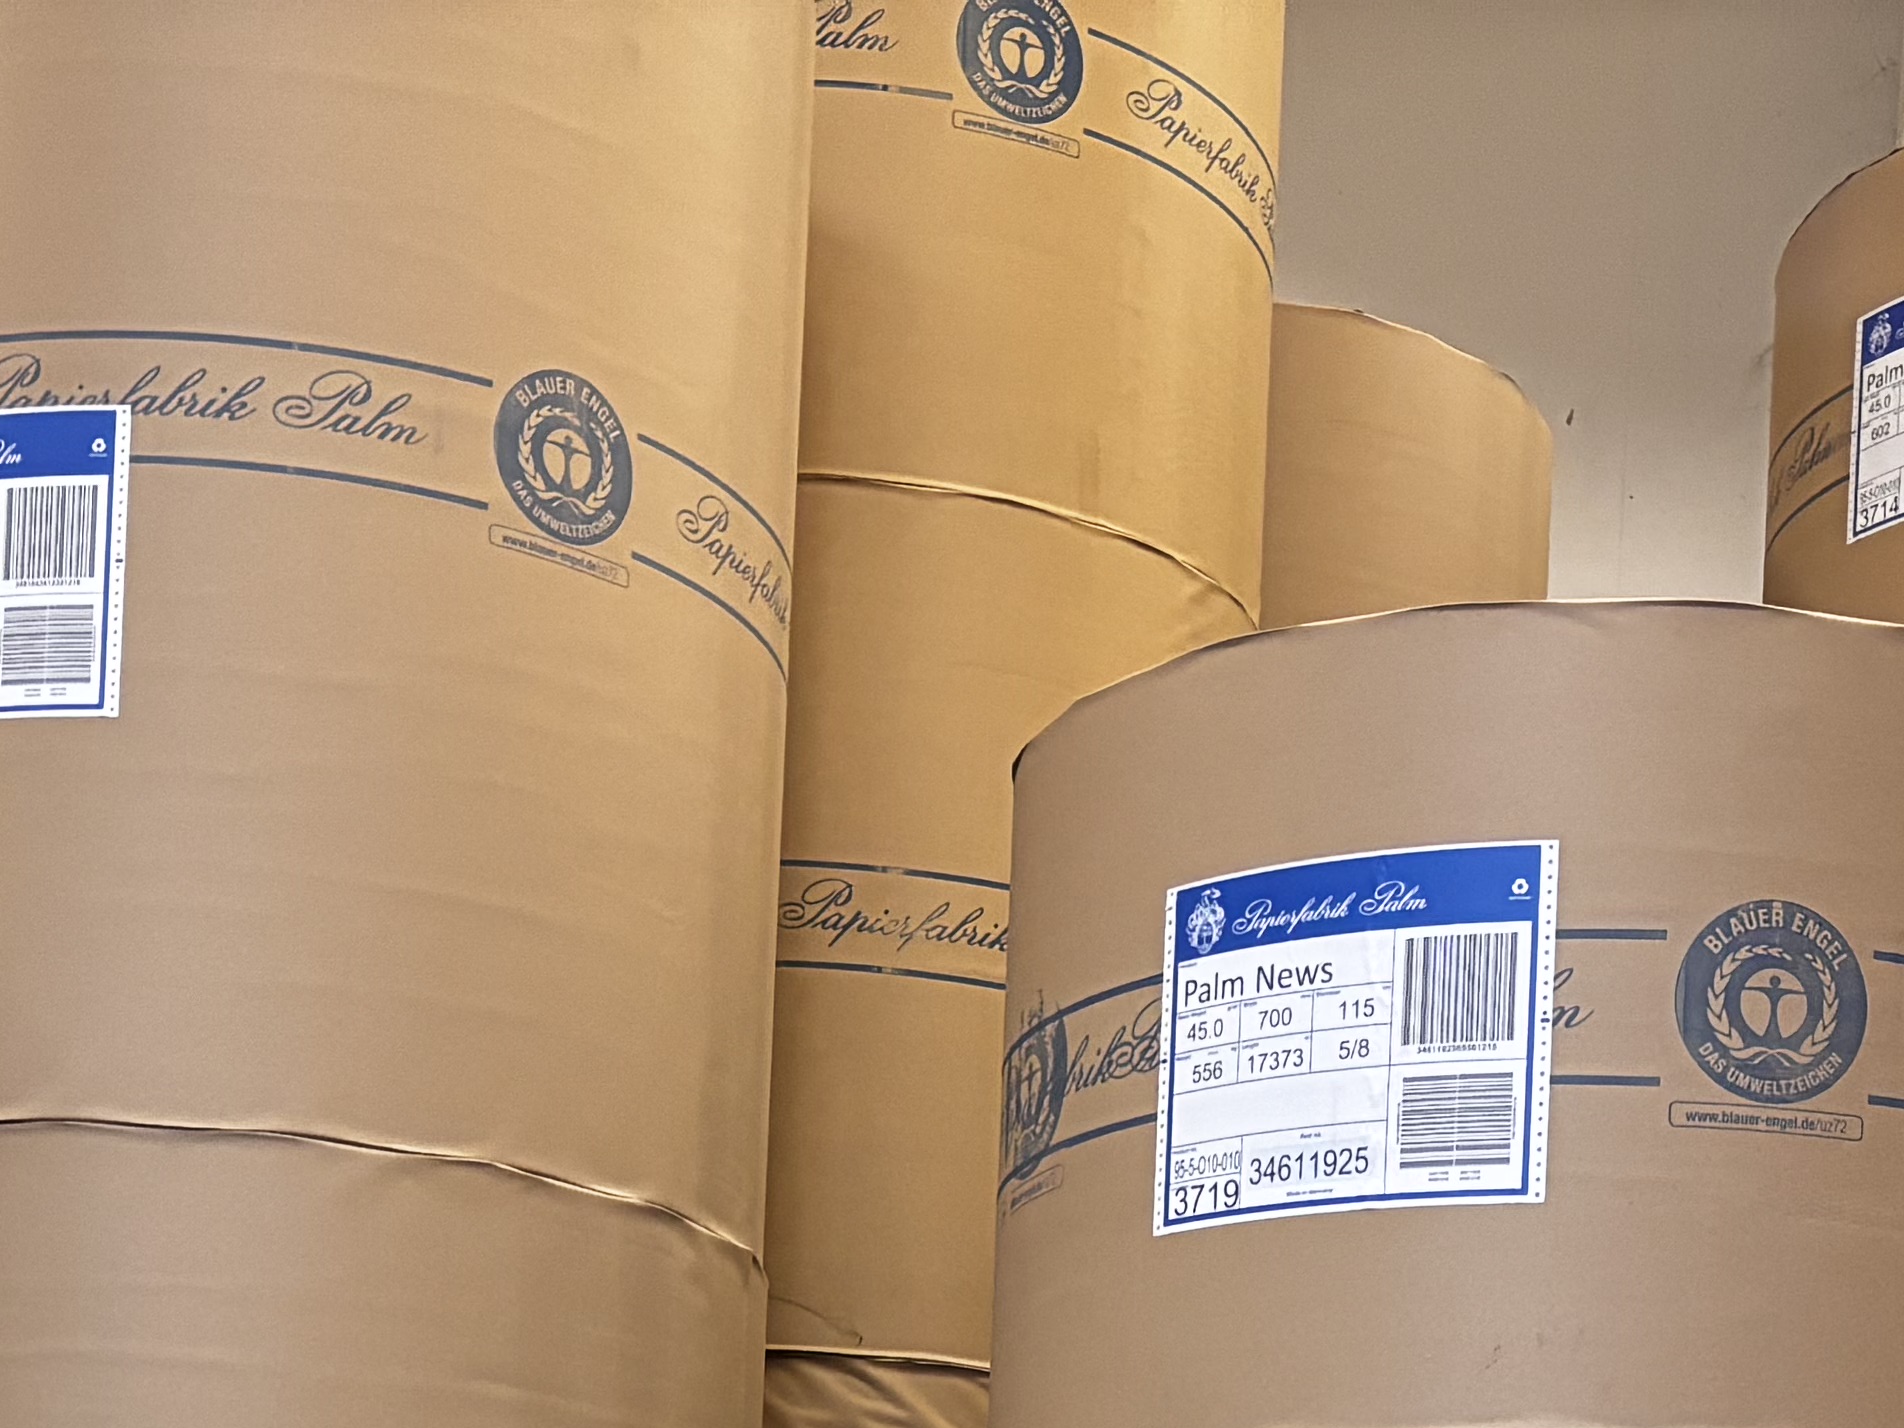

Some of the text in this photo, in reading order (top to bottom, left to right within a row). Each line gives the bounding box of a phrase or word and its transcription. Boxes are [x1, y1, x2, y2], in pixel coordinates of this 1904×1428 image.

[1126, 78, 1259, 207] Papierfabrik
[1866, 362, 1904, 392] Palm
[273, 369, 426, 446] Palm
[515, 376, 622, 443] BLAUER ENGEL
[1871, 422, 1891, 441] 602
[511, 479, 617, 540] DAS UMWELTZEICHEN
[1859, 495, 1900, 528] 3714
[778, 878, 1008, 952] Papierfabrik
[1232, 880, 1428, 939] Papierfabrik Palm
[1703, 905, 1848, 971] BLAUER ENGEL
[1184, 961, 1334, 1008] Palm News
[1187, 998, 1375, 1041] 45.0 700 115
[1192, 1039, 1370, 1084] 556 17373 5/8
[1699, 1042, 1842, 1095] DAS UMWELTZEICHEN
[1249, 1146, 1369, 1186] 34611925
[1174, 1179, 1239, 1216] 3719
